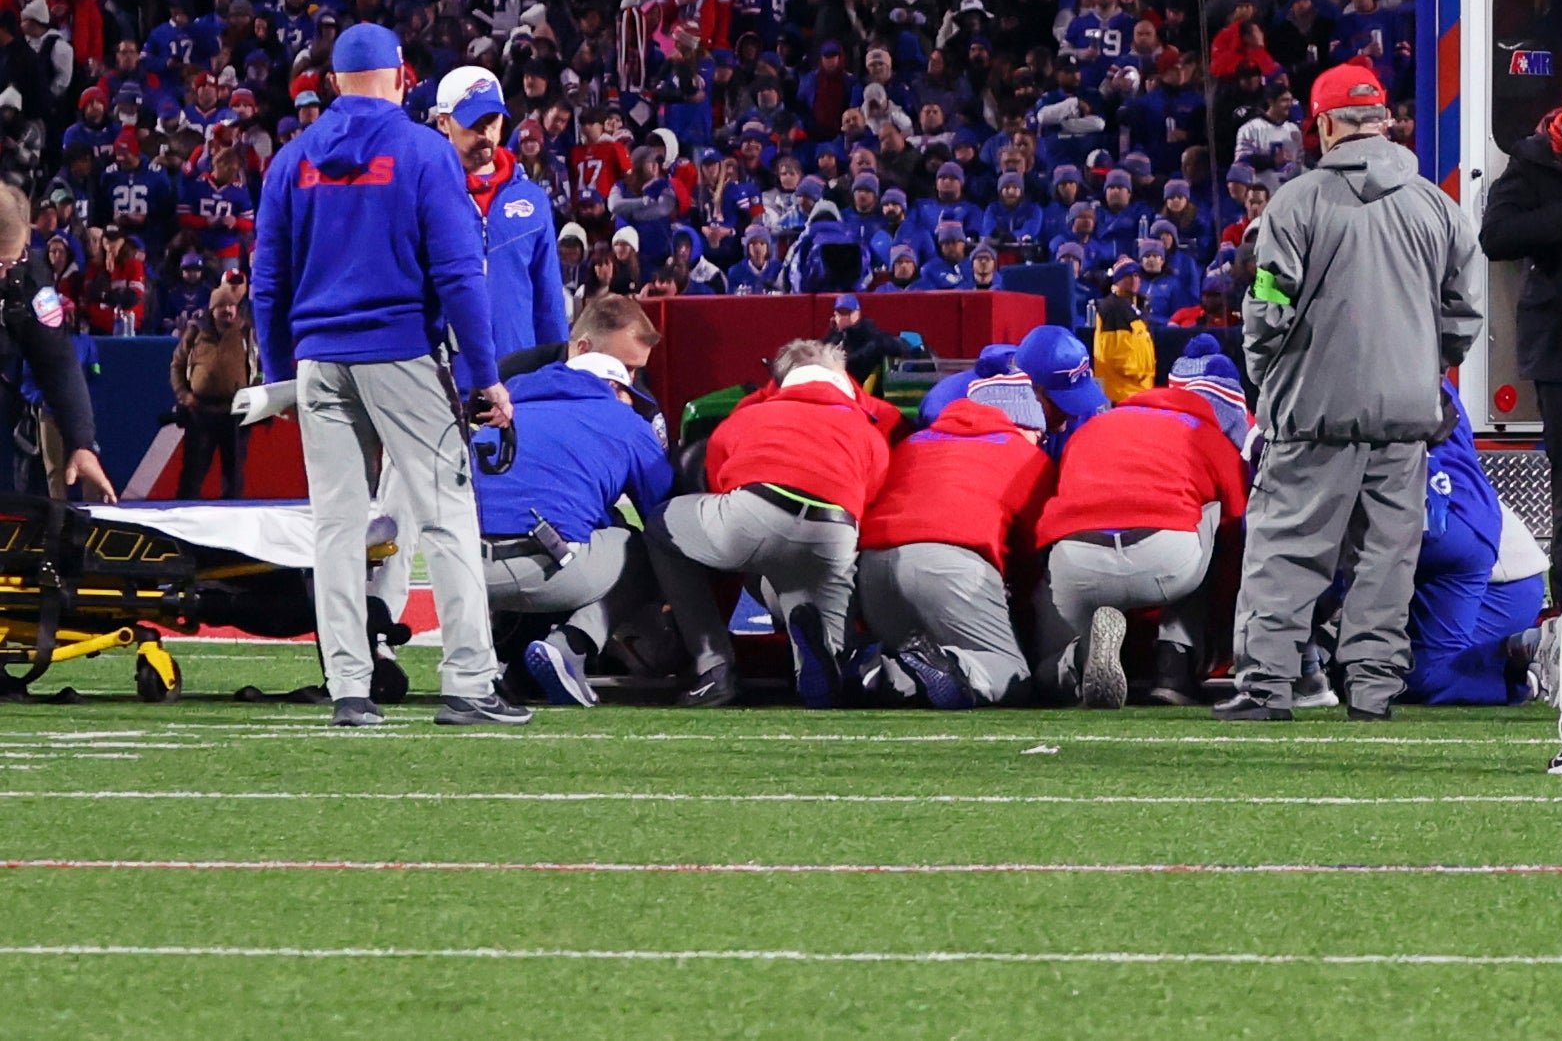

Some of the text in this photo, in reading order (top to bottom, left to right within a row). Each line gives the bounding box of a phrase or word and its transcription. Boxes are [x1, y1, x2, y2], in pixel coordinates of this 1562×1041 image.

[169, 39, 193, 63] 17
[1085, 28, 1121, 56] 79
[1509, 50, 1552, 75] AMR
[578, 160, 603, 189] 17
[113, 184, 148, 215] 26
[200, 197, 232, 220] 50
